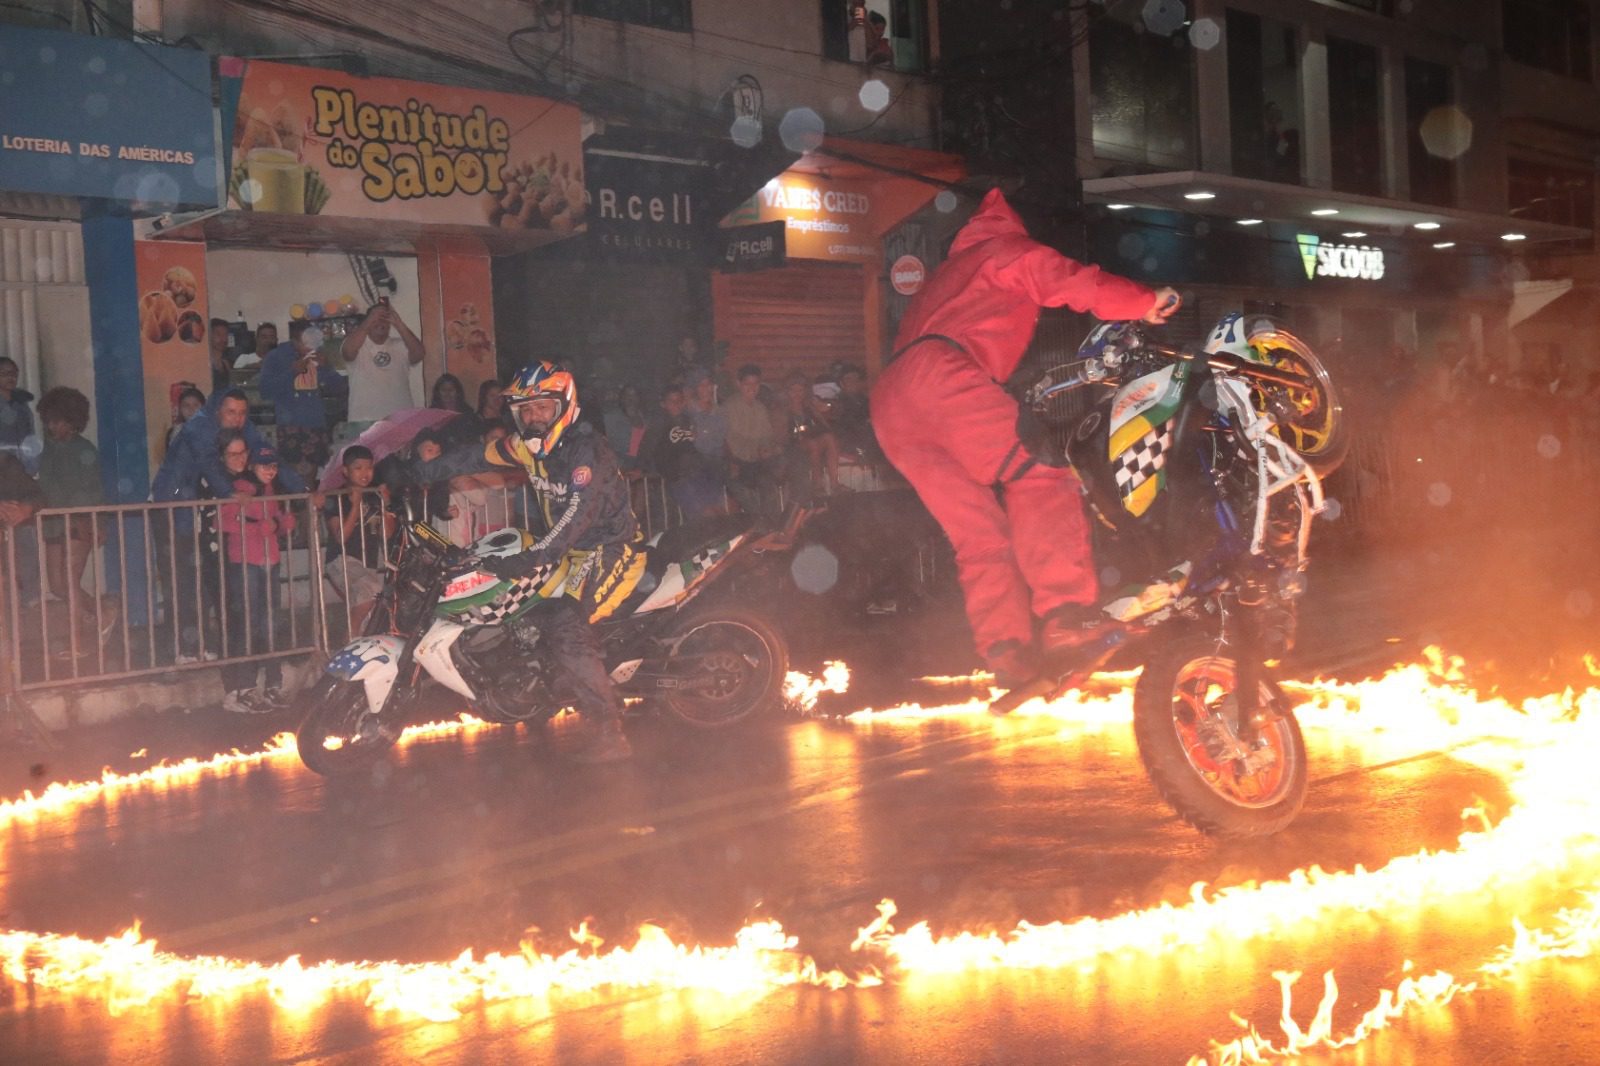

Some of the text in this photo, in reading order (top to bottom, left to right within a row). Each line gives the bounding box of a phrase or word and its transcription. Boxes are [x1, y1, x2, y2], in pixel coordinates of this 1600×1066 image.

[313, 86, 510, 151] Plenitude
[2, 135, 195, 165] LOTERIA DAS AMÉRICAS
[327, 138, 358, 168] do
[360, 138, 506, 201] Sabor
[600, 188, 691, 224] R.cell
[823, 190, 869, 215] CRED
[1316, 242, 1385, 280] SICOOB
